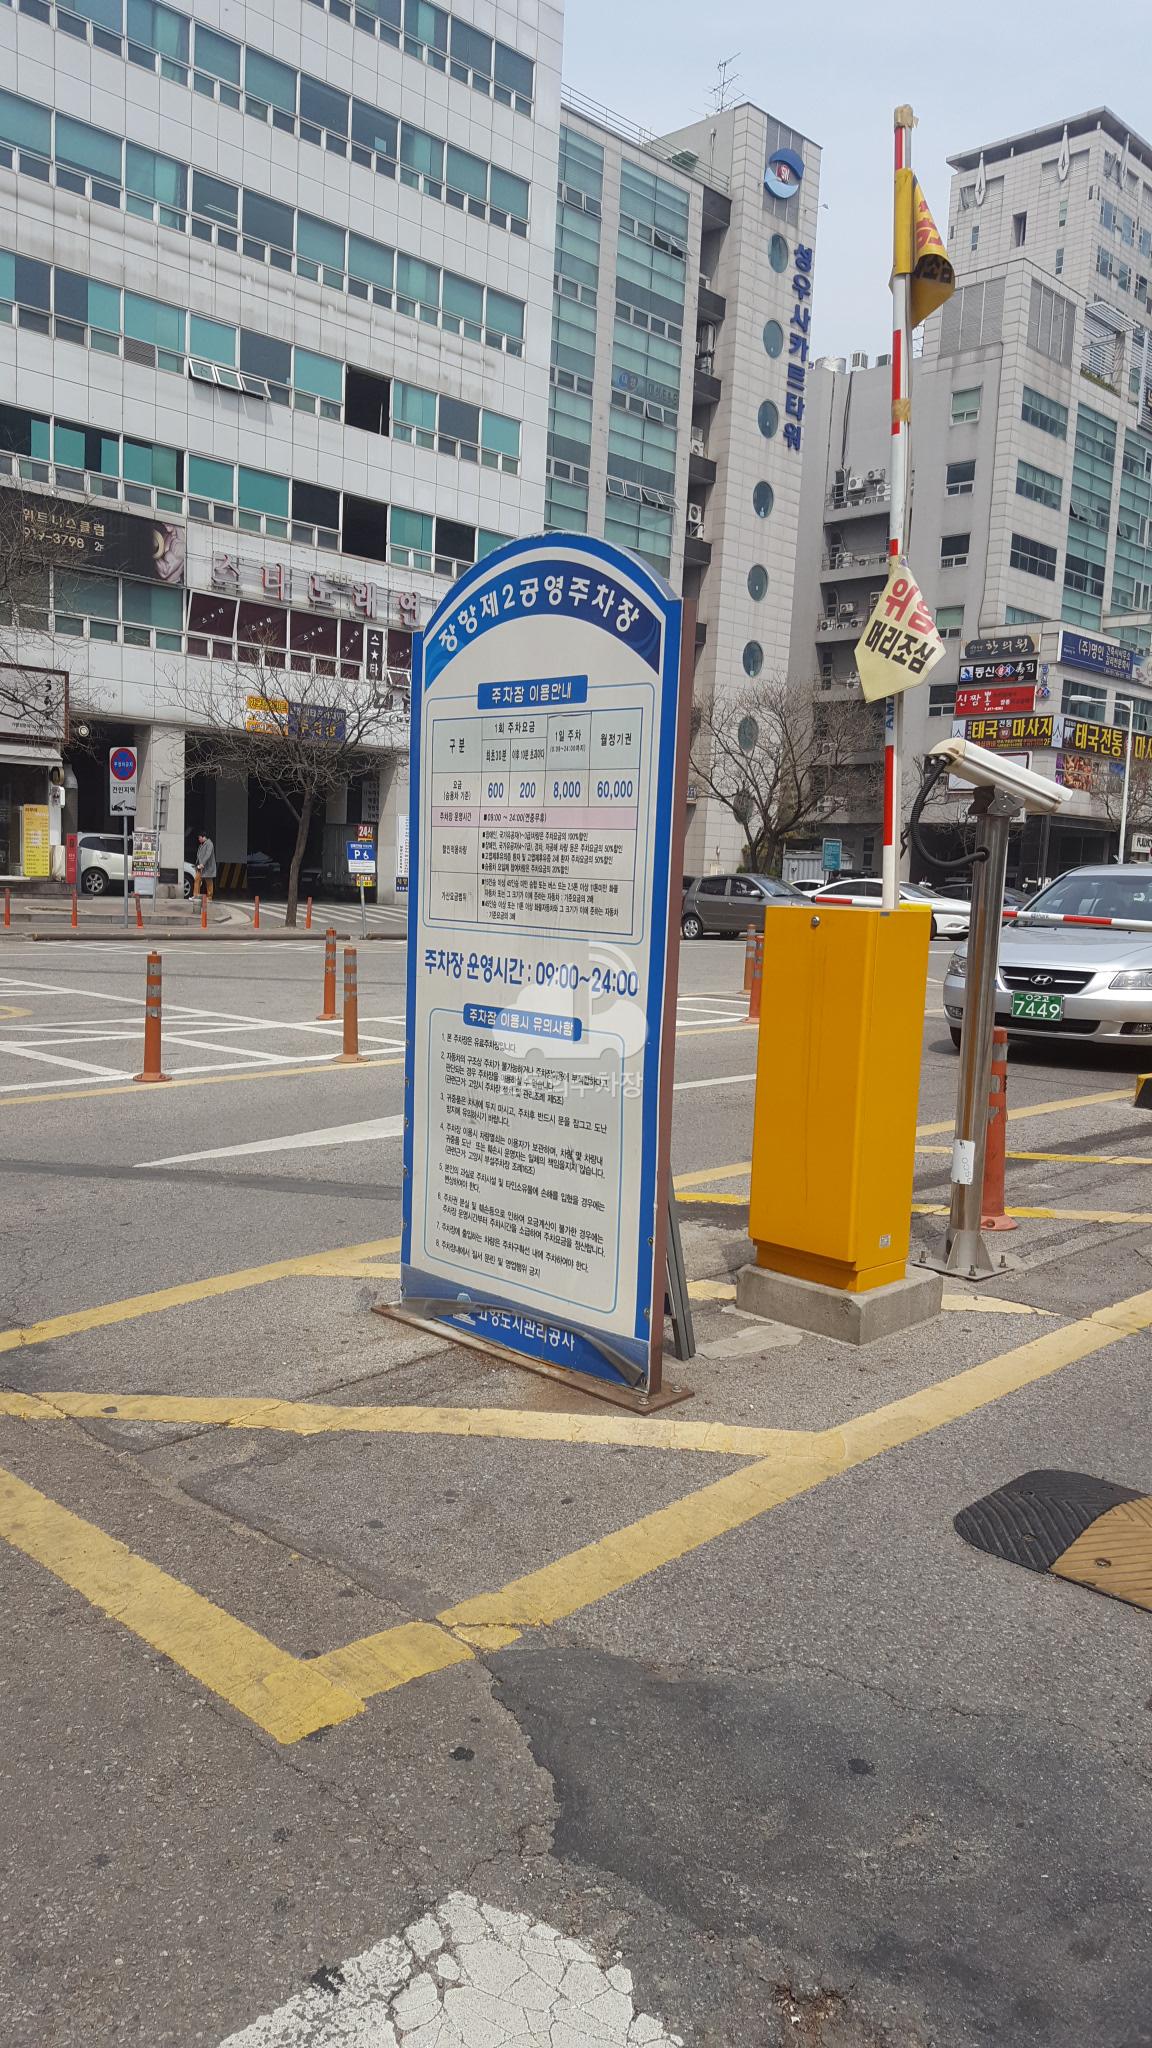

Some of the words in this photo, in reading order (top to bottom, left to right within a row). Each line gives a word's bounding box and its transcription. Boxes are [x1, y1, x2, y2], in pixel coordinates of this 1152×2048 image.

[439, 575, 640, 652] 장항제2공영주차장
[864, 619, 937, 674] 머리조심
[491, 685, 524, 704] 주차장
[529, 682, 572, 702] 이용안내
[494, 722, 504, 734] 1회
[508, 721, 535, 734] 주차요금
[555, 730, 565, 742] 1일
[567, 729, 581, 742] 주차
[972, 720, 998, 739] 태국
[1013, 716, 1052, 737] 마사지
[600, 733, 632, 747] 월정기권
[1075, 723, 1122, 757] 태국전통
[453, 781, 462, 790] 요금
[488, 782, 504, 798] 600
[520, 782, 536, 798] 200
[553, 781, 580, 800] 8,000
[597, 780, 633, 800] 60,000
[425, 949, 464, 979] 주차장
[467, 952, 524, 985] 운영시간
[536, 961, 639, 996] 09:00~24:00
[1014, 1000, 1060, 1019] 7449
[470, 1008, 497, 1025] 주차장
[501, 1011, 529, 1030] 이용시
[533, 1017, 574, 1036] 유의사항
[454, 1034, 472, 1046] 주차장은
[447, 1052, 466, 1064] 자동차의
[467, 1055, 482, 1067] 구조상
[484, 1058, 500, 1070] 주차가
[501, 1061, 533, 1075] 불가능하거나
[468, 1079, 483, 1090] 고양시
[485, 1082, 500, 1094] 주차장
[478, 1069, 498, 1082] 주차장을
[485, 1101, 496, 1112] 두지
[518, 1108, 535, 1120] 주차후
[537, 1111, 556, 1124] 반드시
[558, 1116, 570, 1127] 문을
[573, 1118, 592, 1131] 잠그고
[594, 1123, 607, 1134] 도난
[446, 1123, 461, 1135] 주차장
[463, 1127, 477, 1139] 이용시
[507, 1137, 530, 1151] 이용자가
[560, 1148, 573, 1160] 차량
[584, 1153, 603, 1166] 차량내
[446, 1134, 460, 1146] 귀중품
[462, 1138, 471, 1148] 도난
[476, 1141, 486, 1152] 또는
[504, 1148, 526, 1162] 운영자는
[468, 1151, 483, 1163] 고양시
[476, 1172, 497, 1186] 주차시설
[540, 1188, 559, 1201] 손해를
[581, 1197, 605, 1212] 경우에는
[441, 1222, 460, 1236] 주차장에
[462, 1228, 482, 1243] 출입하는
[484, 1235, 500, 1248] 차량은
[442, 1204, 457, 1217] 주차장
[458, 1209, 487, 1226] 운영시간부터
[490, 1218, 517, 1234] 주차시간을
[519, 1226, 542, 1240] 소급하여
[544, 1231, 572, 1248] 주차요금을
[508, 1210, 525, 1224] 인하여
[527, 1216, 556, 1232] 요금계산이
[559, 1223, 577, 1237] 불가한
[579, 1229, 604, 1245] 경우에는
[472, 1250, 483, 1261] 질서
[484, 1253, 495, 1265] 문란
[505, 1259, 528, 1274] 영업행위
[529, 1266, 541, 1279] 금지
